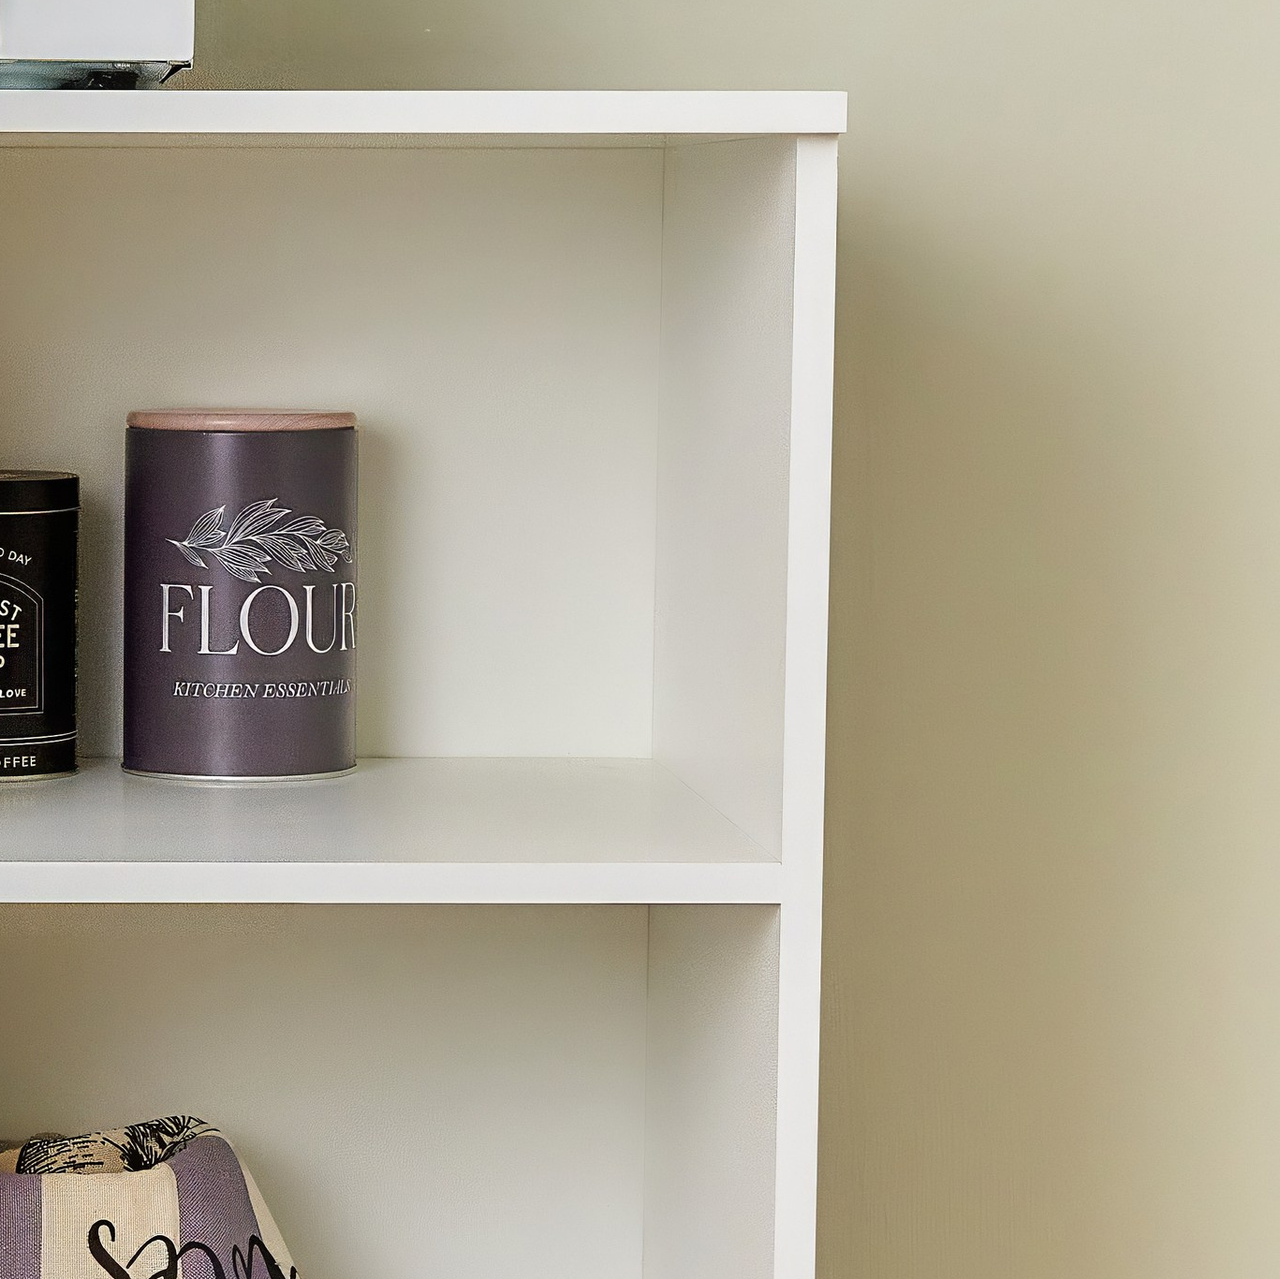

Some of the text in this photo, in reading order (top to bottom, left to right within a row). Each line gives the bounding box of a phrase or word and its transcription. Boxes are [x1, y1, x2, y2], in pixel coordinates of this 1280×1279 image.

[7, 550, 33, 566] DAY
[159, 581, 357, 656] FLOUR
[0, 688, 27, 699] LOVE
[172, 680, 260, 699] KITCHEN
